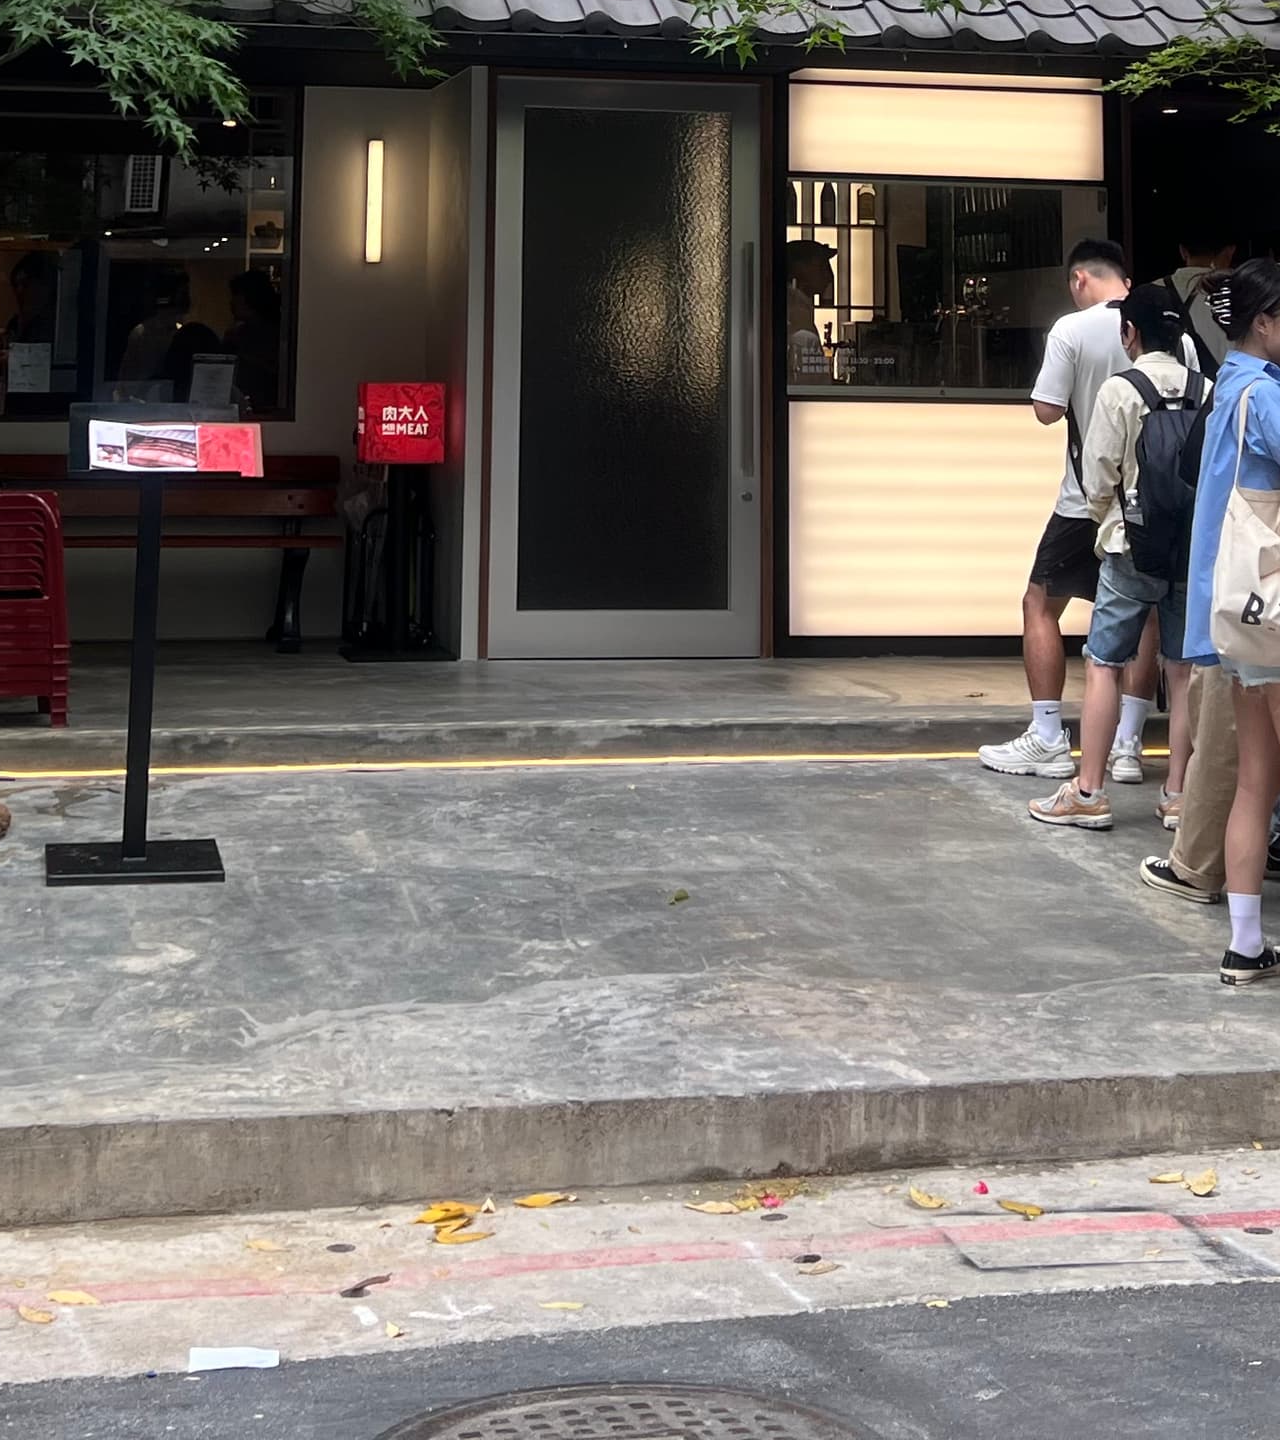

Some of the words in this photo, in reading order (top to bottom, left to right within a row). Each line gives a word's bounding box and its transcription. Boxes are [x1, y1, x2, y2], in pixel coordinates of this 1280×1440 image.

[382, 405, 429, 421] 肉大人
[396, 423, 429, 435] MEAT
